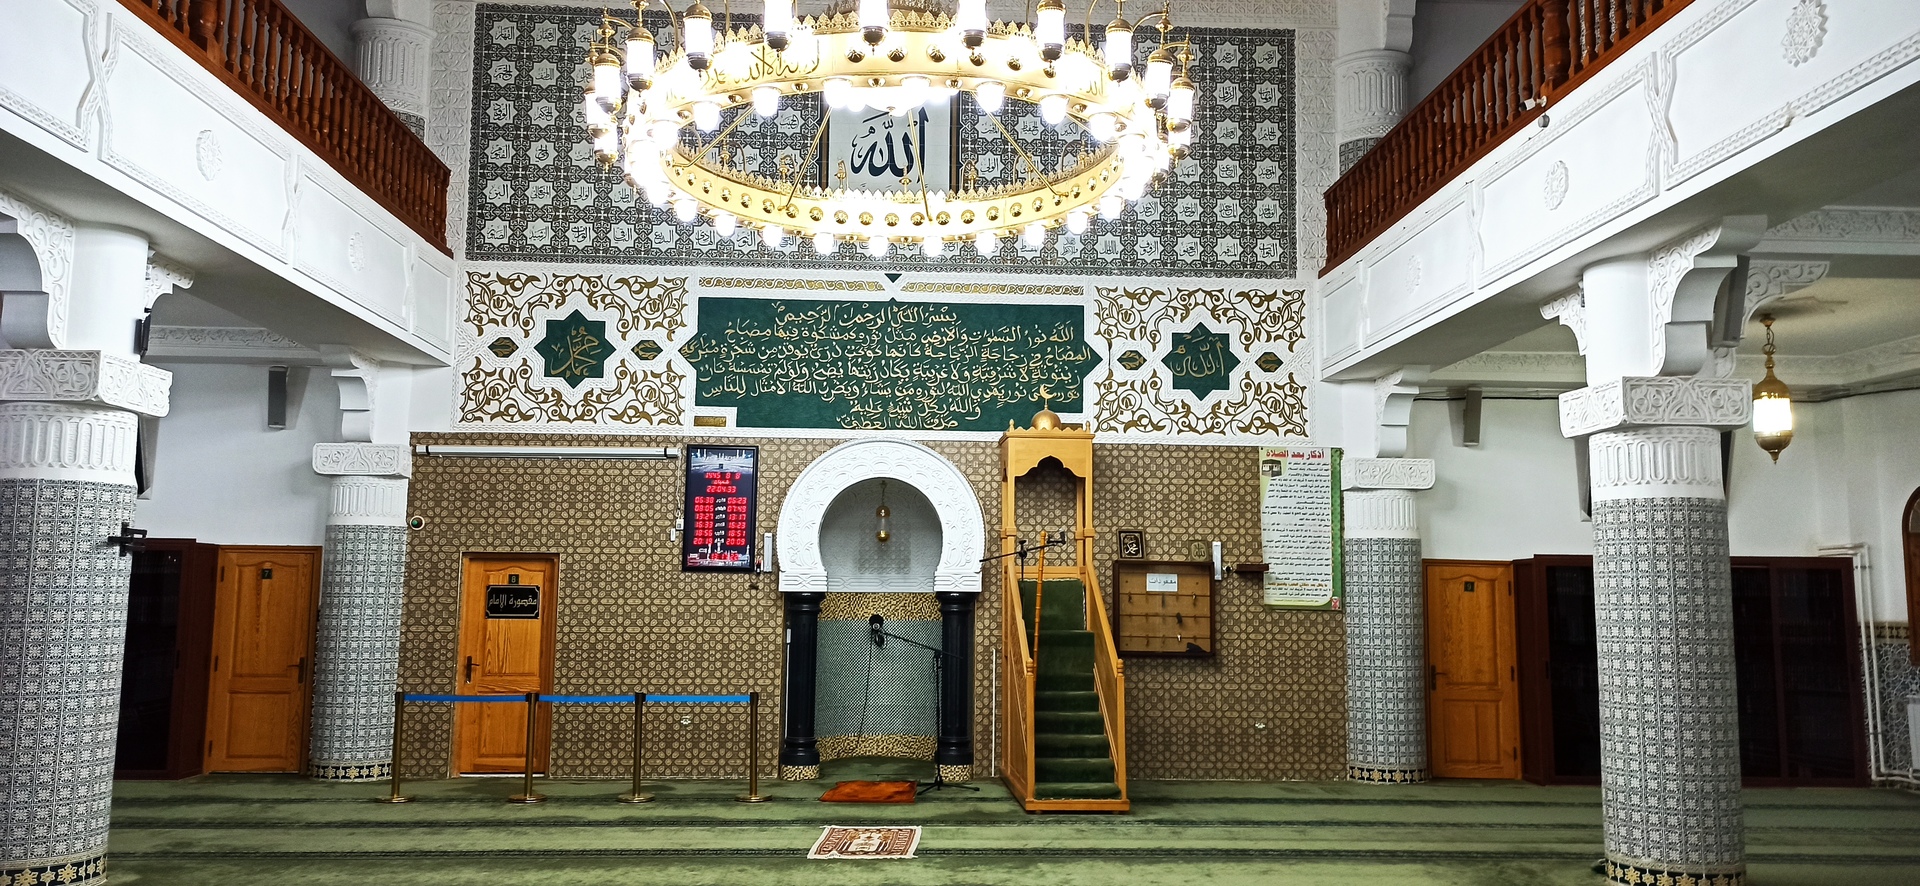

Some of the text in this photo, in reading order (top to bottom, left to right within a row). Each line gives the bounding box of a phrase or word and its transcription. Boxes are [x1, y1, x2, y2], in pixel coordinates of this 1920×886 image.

[850, 107, 930, 184] الله
[550, 325, 603, 379] محمد
[1169, 328, 1225, 378] الله
[1266, 448, 1325, 460] أذكار بعد الصلاة
[1148, 576, 1177, 586] مفقودات
[488, 593, 537, 610] مقصورة الإمام
